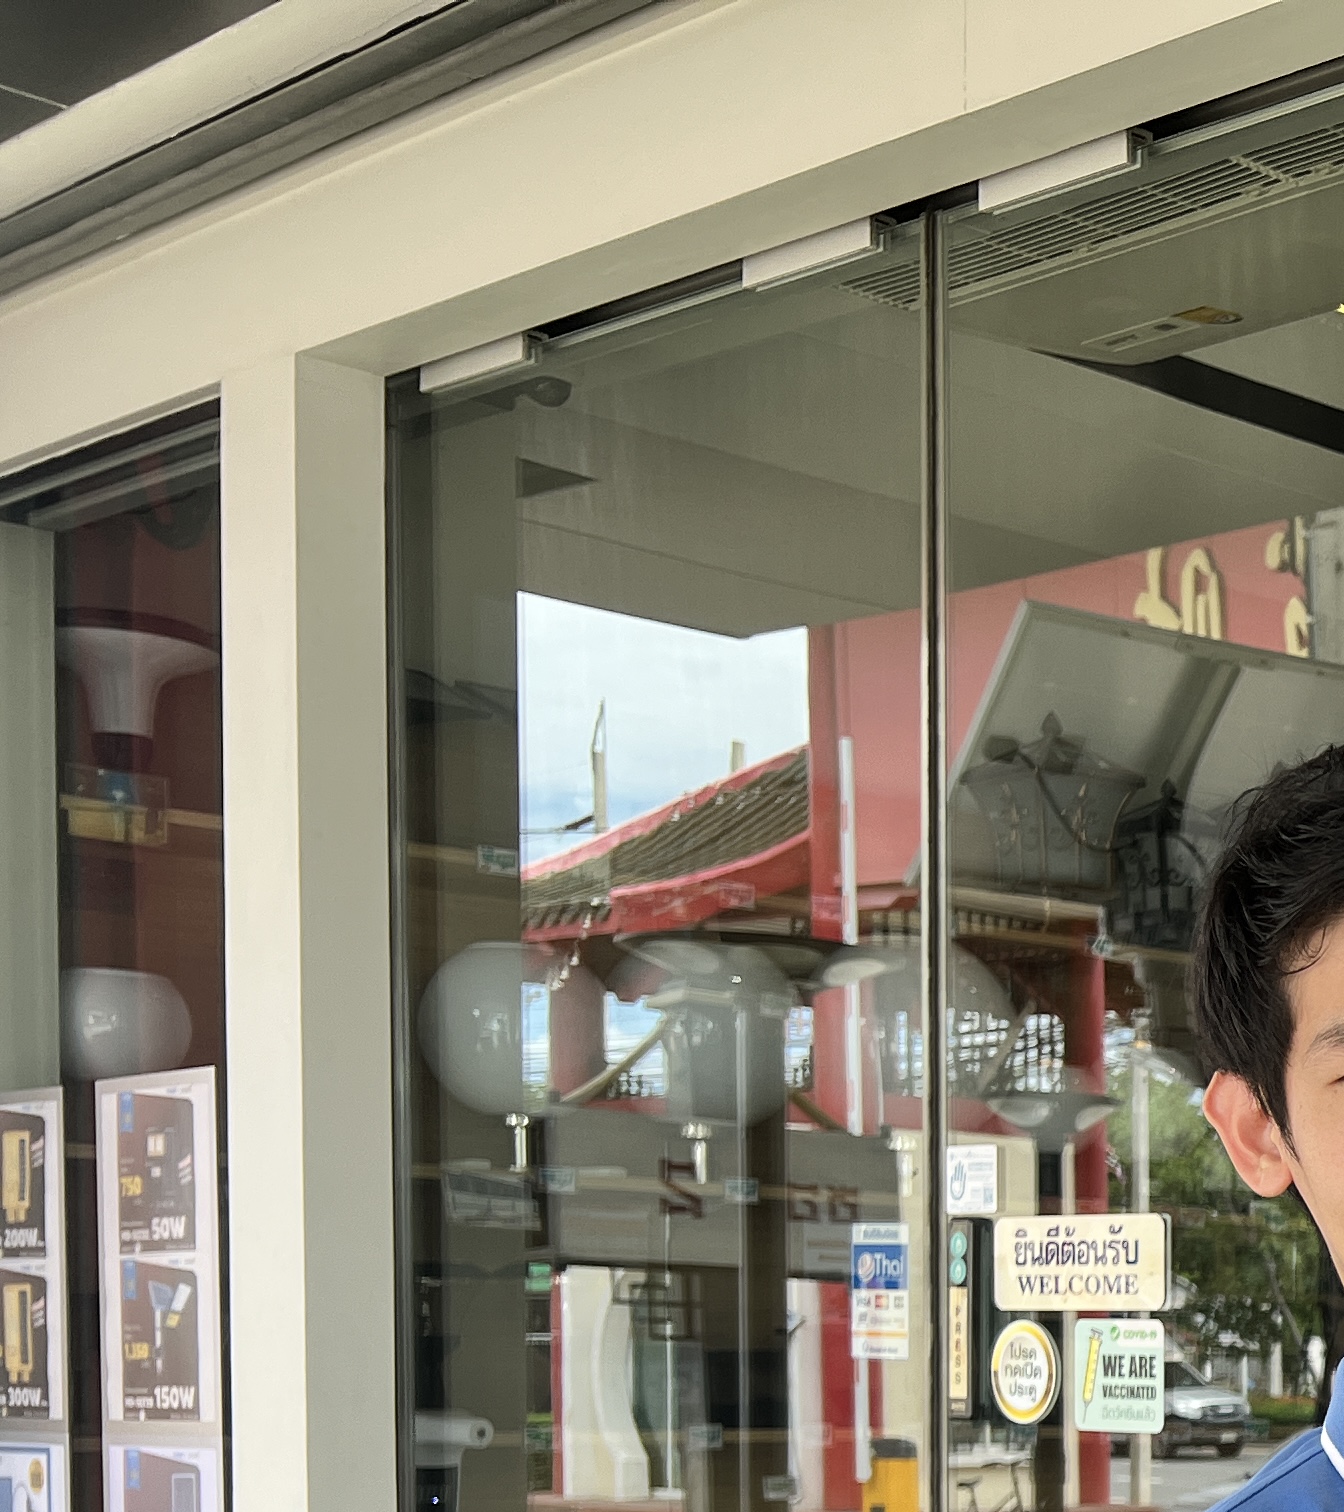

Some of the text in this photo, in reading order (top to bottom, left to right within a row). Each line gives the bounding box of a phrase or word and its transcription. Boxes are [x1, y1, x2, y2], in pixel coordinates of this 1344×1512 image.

[1014, 1224, 1139, 1266] ยินดีต้อนรับ
[1017, 1274, 1139, 1296] WELCOME
[1103, 1354, 1157, 1379] WE ARE
[1103, 1384, 1157, 1400] VACCINATED
